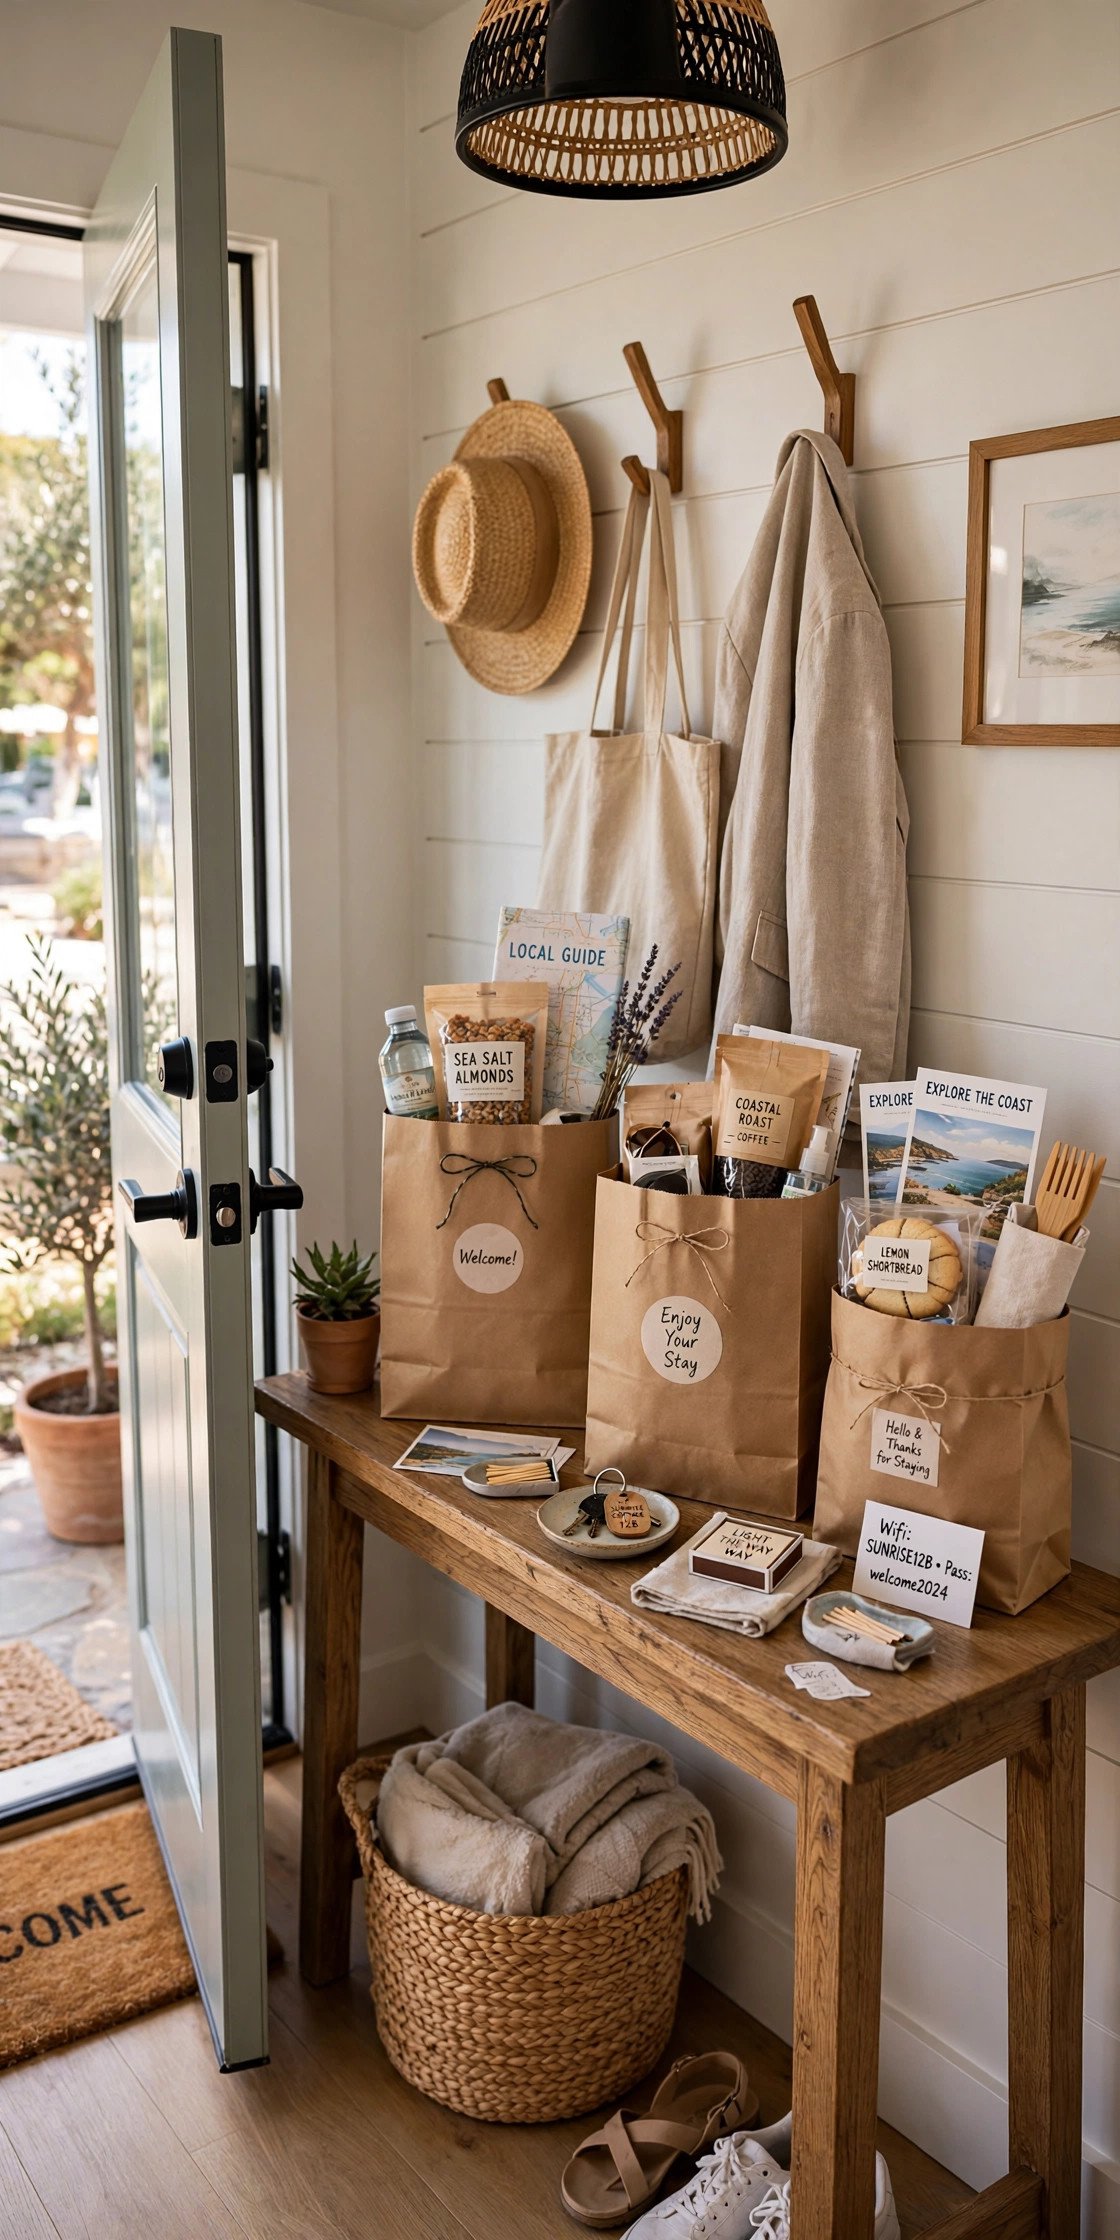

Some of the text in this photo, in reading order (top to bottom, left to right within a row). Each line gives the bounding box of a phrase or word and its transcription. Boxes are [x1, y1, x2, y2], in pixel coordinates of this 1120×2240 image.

[509, 942, 606, 966] LOCAL GUIDE
[454, 1051, 513, 1066] SEA SALT
[455, 1069, 514, 1084] ALMONDS
[735, 1097, 781, 1115] COASTAL
[869, 1092, 913, 1108] EXPLORE
[925, 1081, 972, 1102] EXPLORE
[975, 1090, 995, 1107] THE
[998, 1094, 1033, 1113] COAST
[738, 1112, 774, 1130] ROAST
[737, 1132, 769, 1145] COFFEE
[460, 1249, 517, 1266] Welcome!
[880, 1246, 909, 1259] LEMON
[867, 1259, 923, 1275] SHORTBREAD
[660, 1306, 701, 1334] Enjoy
[665, 1329, 698, 1348] Your
[664, 1350, 697, 1377] Stay
[885, 1419, 922, 1439] Hello &
[886, 1437, 921, 1456] Thanks
[876, 1450, 930, 1479] for Staying
[732, 1529, 772, 1543] LIGHT
[879, 1518, 911, 1542] Wifi:
[725, 1548, 753, 1560] WAY
[865, 1538, 933, 1569] SUNRISE12B
[944, 1560, 972, 1581] Pass:
[870, 1568, 948, 1601] welcome2024
[0, 1883, 145, 1963] COME
